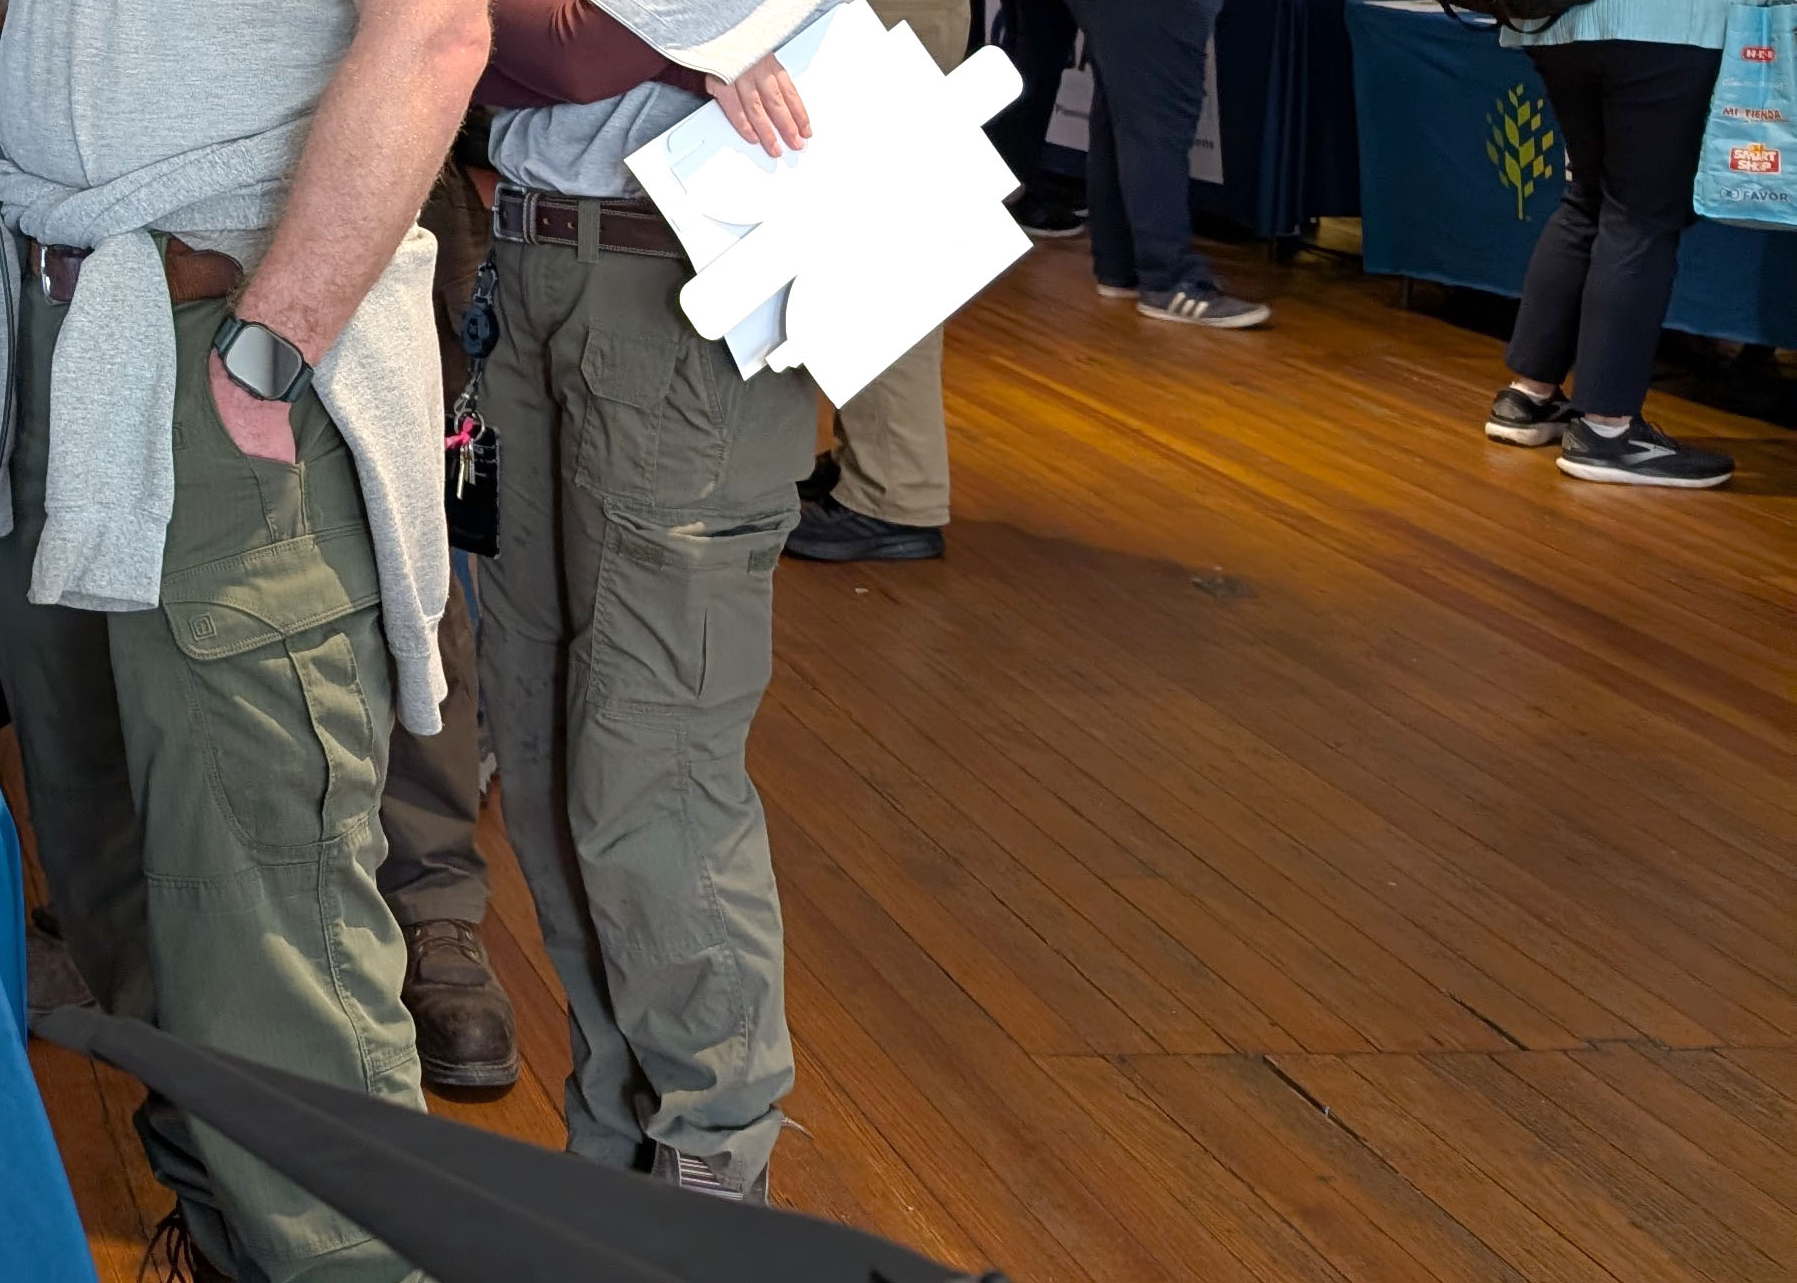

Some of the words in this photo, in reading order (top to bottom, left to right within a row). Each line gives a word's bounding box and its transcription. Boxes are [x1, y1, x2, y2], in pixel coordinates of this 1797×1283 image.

[1733, 150, 1777, 162] SMART
[1737, 160, 1772, 171] SHOP
[1742, 191, 1789, 202] FAVOR
